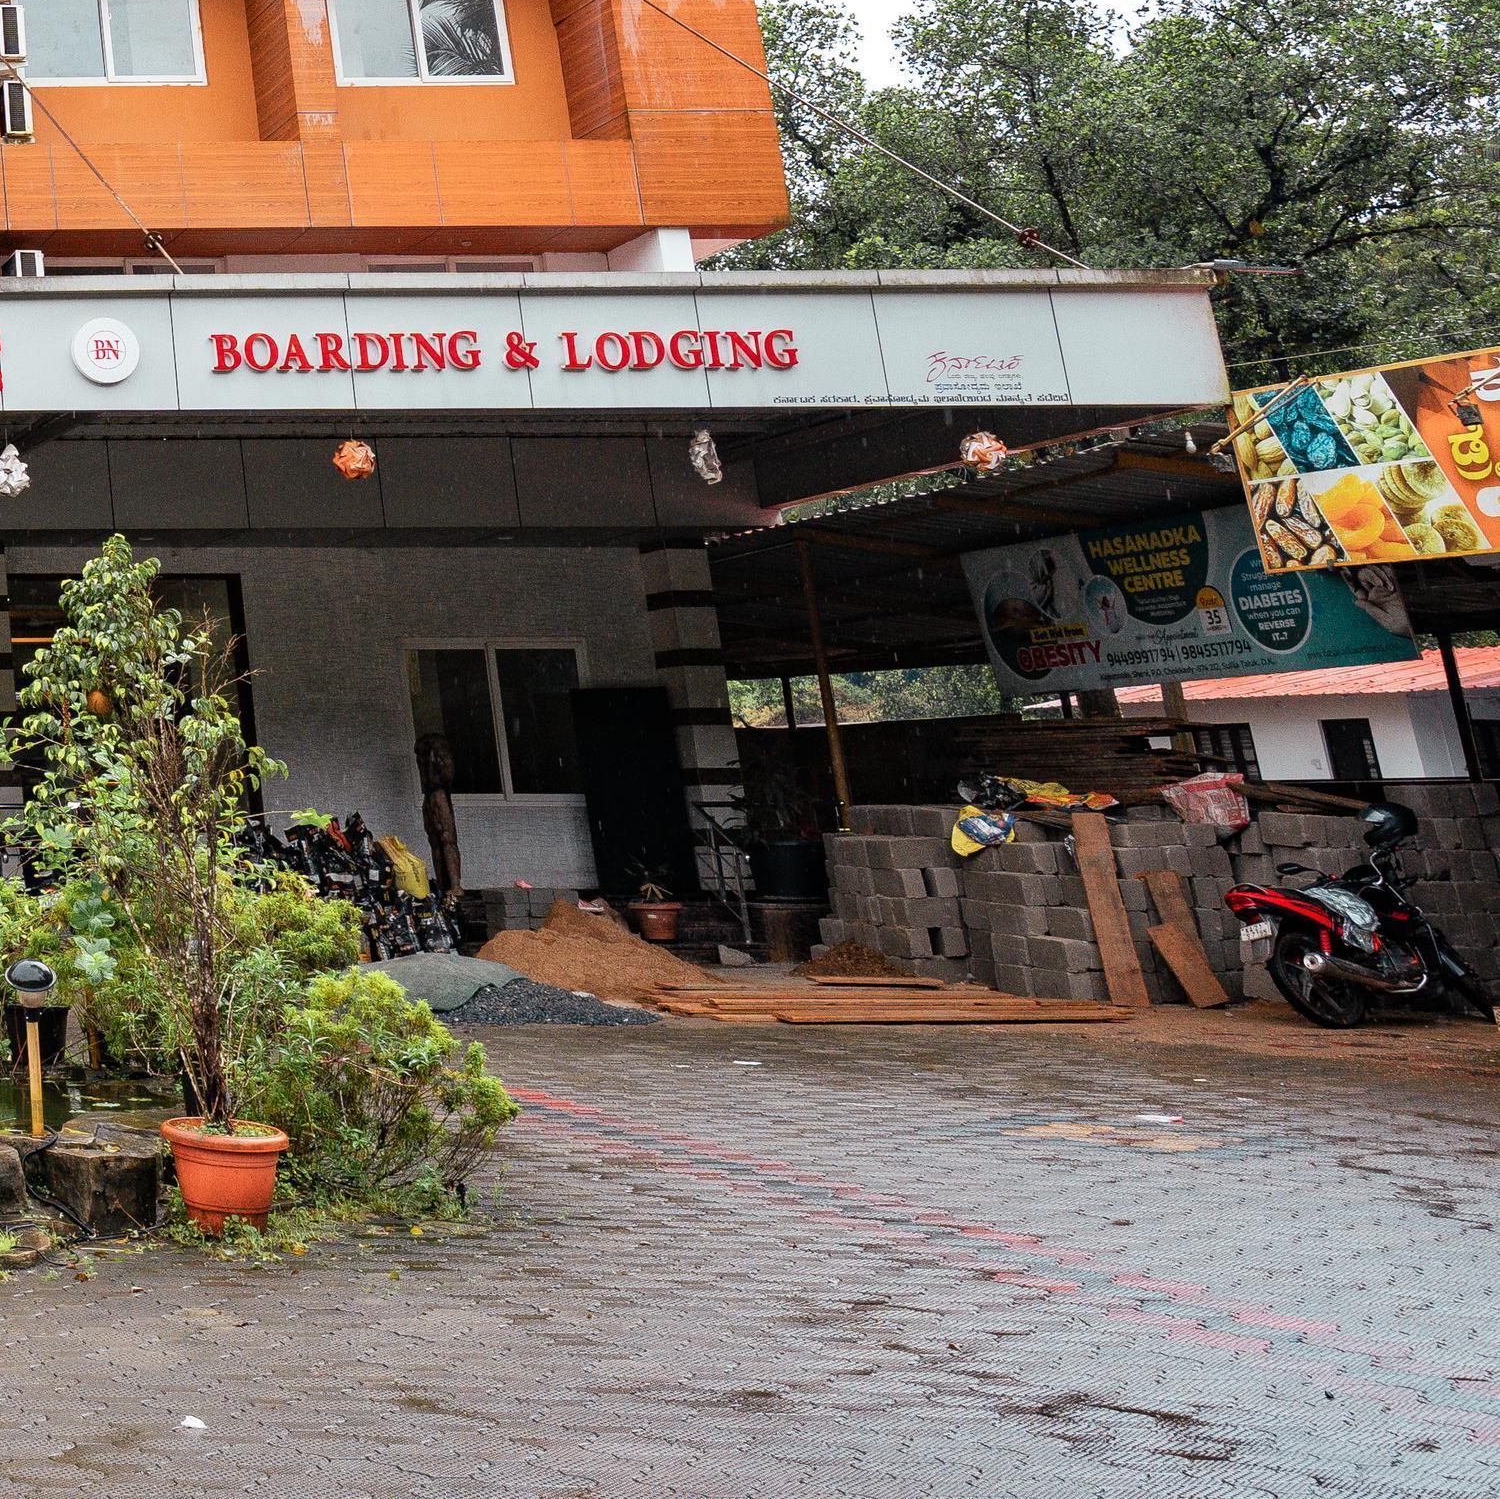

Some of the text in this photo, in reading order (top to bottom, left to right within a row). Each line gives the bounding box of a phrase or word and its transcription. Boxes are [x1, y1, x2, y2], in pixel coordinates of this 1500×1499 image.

[92, 339, 121, 360] BN
[210, 330, 800, 373] BOARDING & LODGING
[1088, 524, 1202, 559] HASANADKA
[1107, 548, 1191, 576] WELLNESS
[1124, 570, 1185, 593] CENTRE
[1250, 580, 1282, 592] manage
[1239, 589, 1303, 611] DIABETES
[1206, 610, 1222, 625] 35
[1247, 607, 1300, 621] when you can
[1258, 619, 1296, 632] REVERSE
[1017, 640, 1101, 672] OBESITY
